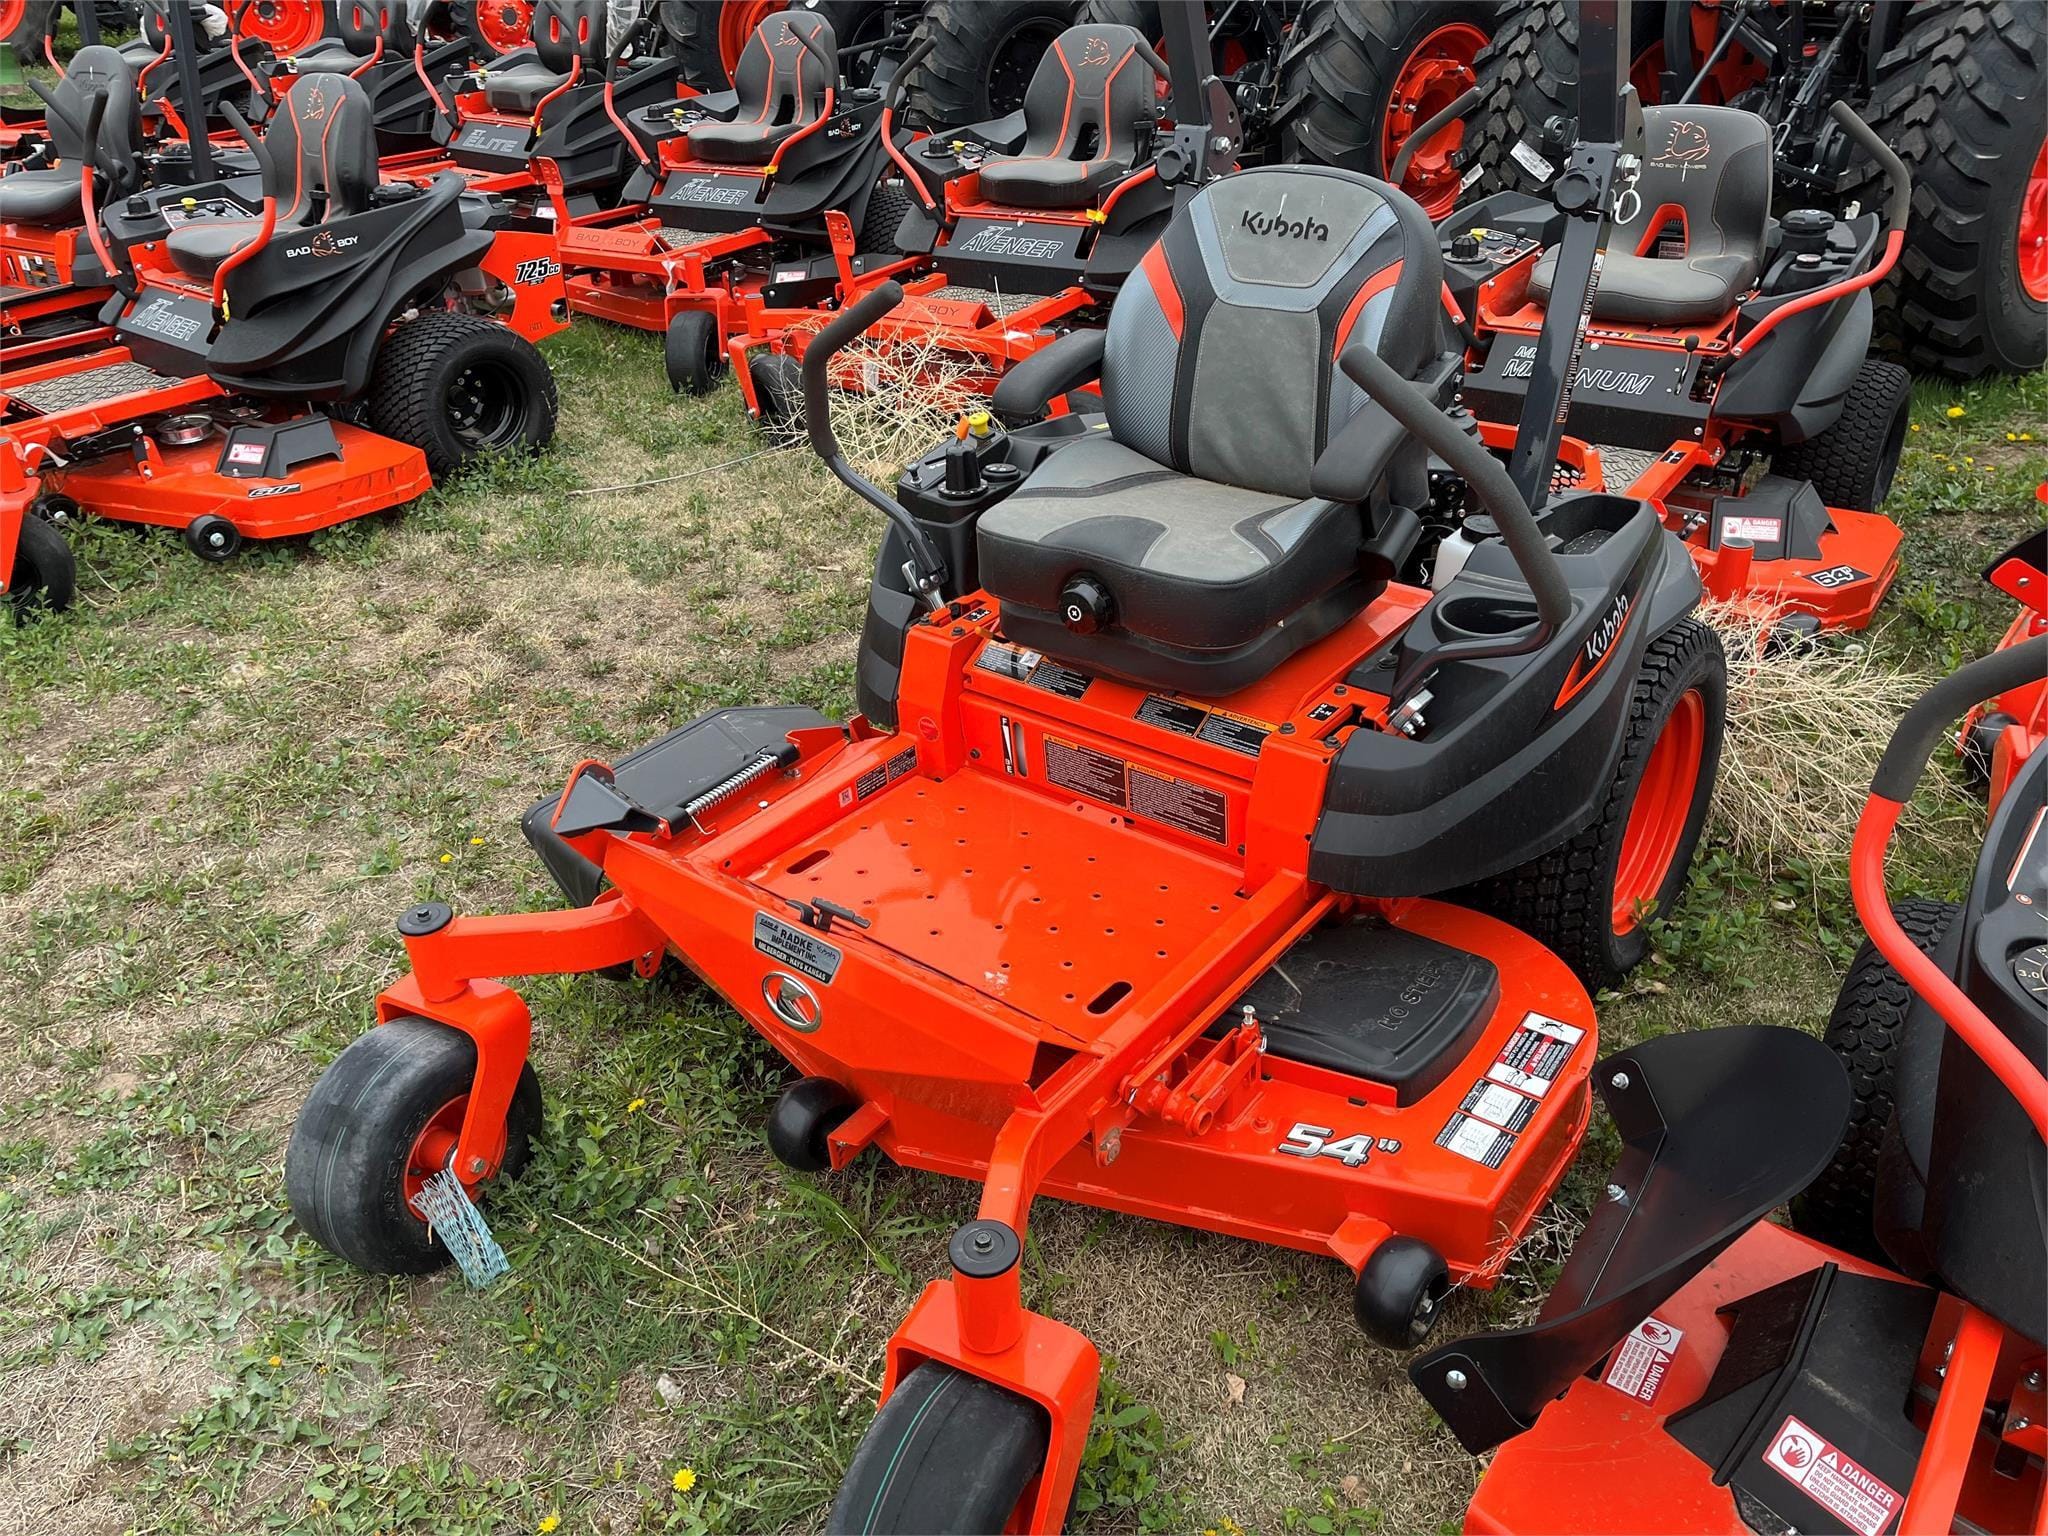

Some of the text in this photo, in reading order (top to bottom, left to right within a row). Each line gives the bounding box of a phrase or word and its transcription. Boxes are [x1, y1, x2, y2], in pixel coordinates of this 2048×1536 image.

[462, 135, 519, 153] ELITE
[670, 185, 749, 206] AVENGER
[1241, 210, 1329, 242] Kubota
[286, 236, 359, 258] BAD BOY
[576, 233, 640, 248] BAD BOY
[960, 233, 1063, 259] AVENGER
[927, 305, 960, 317] BOY
[131, 308, 202, 341] AVENGER
[1586, 594, 1629, 660] Kubota
[771, 934, 804, 956] IMPLEMENT
[780, 928, 813, 951] RADKE
[803, 964, 826, 980] KANSAS
[2018, 968, 2040, 979] 3.0
[1278, 1122, 1402, 1167] 54"
[1637, 1363, 1664, 1401] DANGER
[1813, 1469, 1881, 1522] DO NOT OPERATE MOWER
[1816, 1462, 1831, 1475] KEEP
[1829, 1472, 1850, 1489] HANDS
[1853, 1490, 1869, 1503] FEET
[1838, 1462, 1896, 1508] DANGER
[1807, 1483, 1834, 1505] CATCHER
[1832, 1502, 1840, 1510] IS
[1808, 1474, 1877, 1528] UNLESS GUARD OR GRASS
